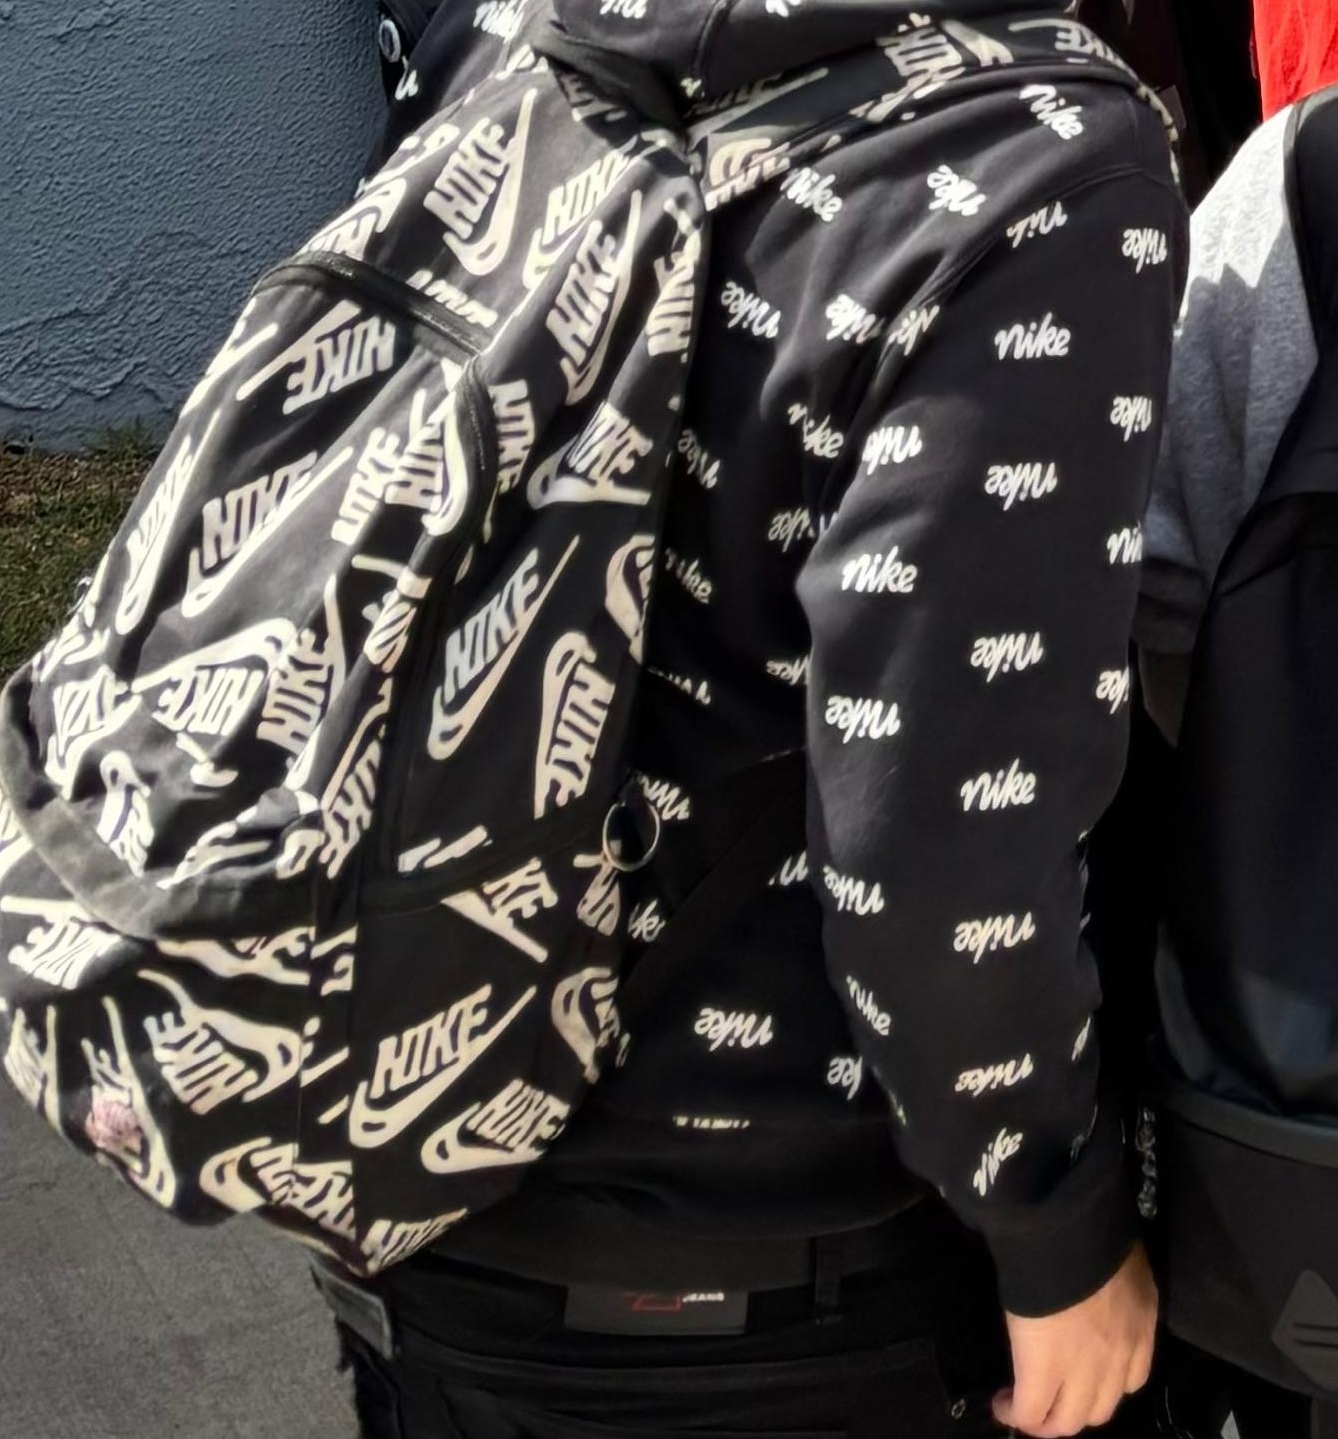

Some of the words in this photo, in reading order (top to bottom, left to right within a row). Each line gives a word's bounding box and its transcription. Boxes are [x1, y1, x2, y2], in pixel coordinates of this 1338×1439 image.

[423, 116, 505, 240] NIKE
[545, 219, 616, 366] NIKE
[282, 315, 396, 414] NIKE
[202, 449, 318, 570] NIKE
[445, 549, 540, 695] NIKE
[256, 627, 331, 759] NIKE
[145, 1012, 261, 1114] NIKE
[371, 984, 493, 1097] NIKE
[469, 1079, 562, 1152] NIKE
